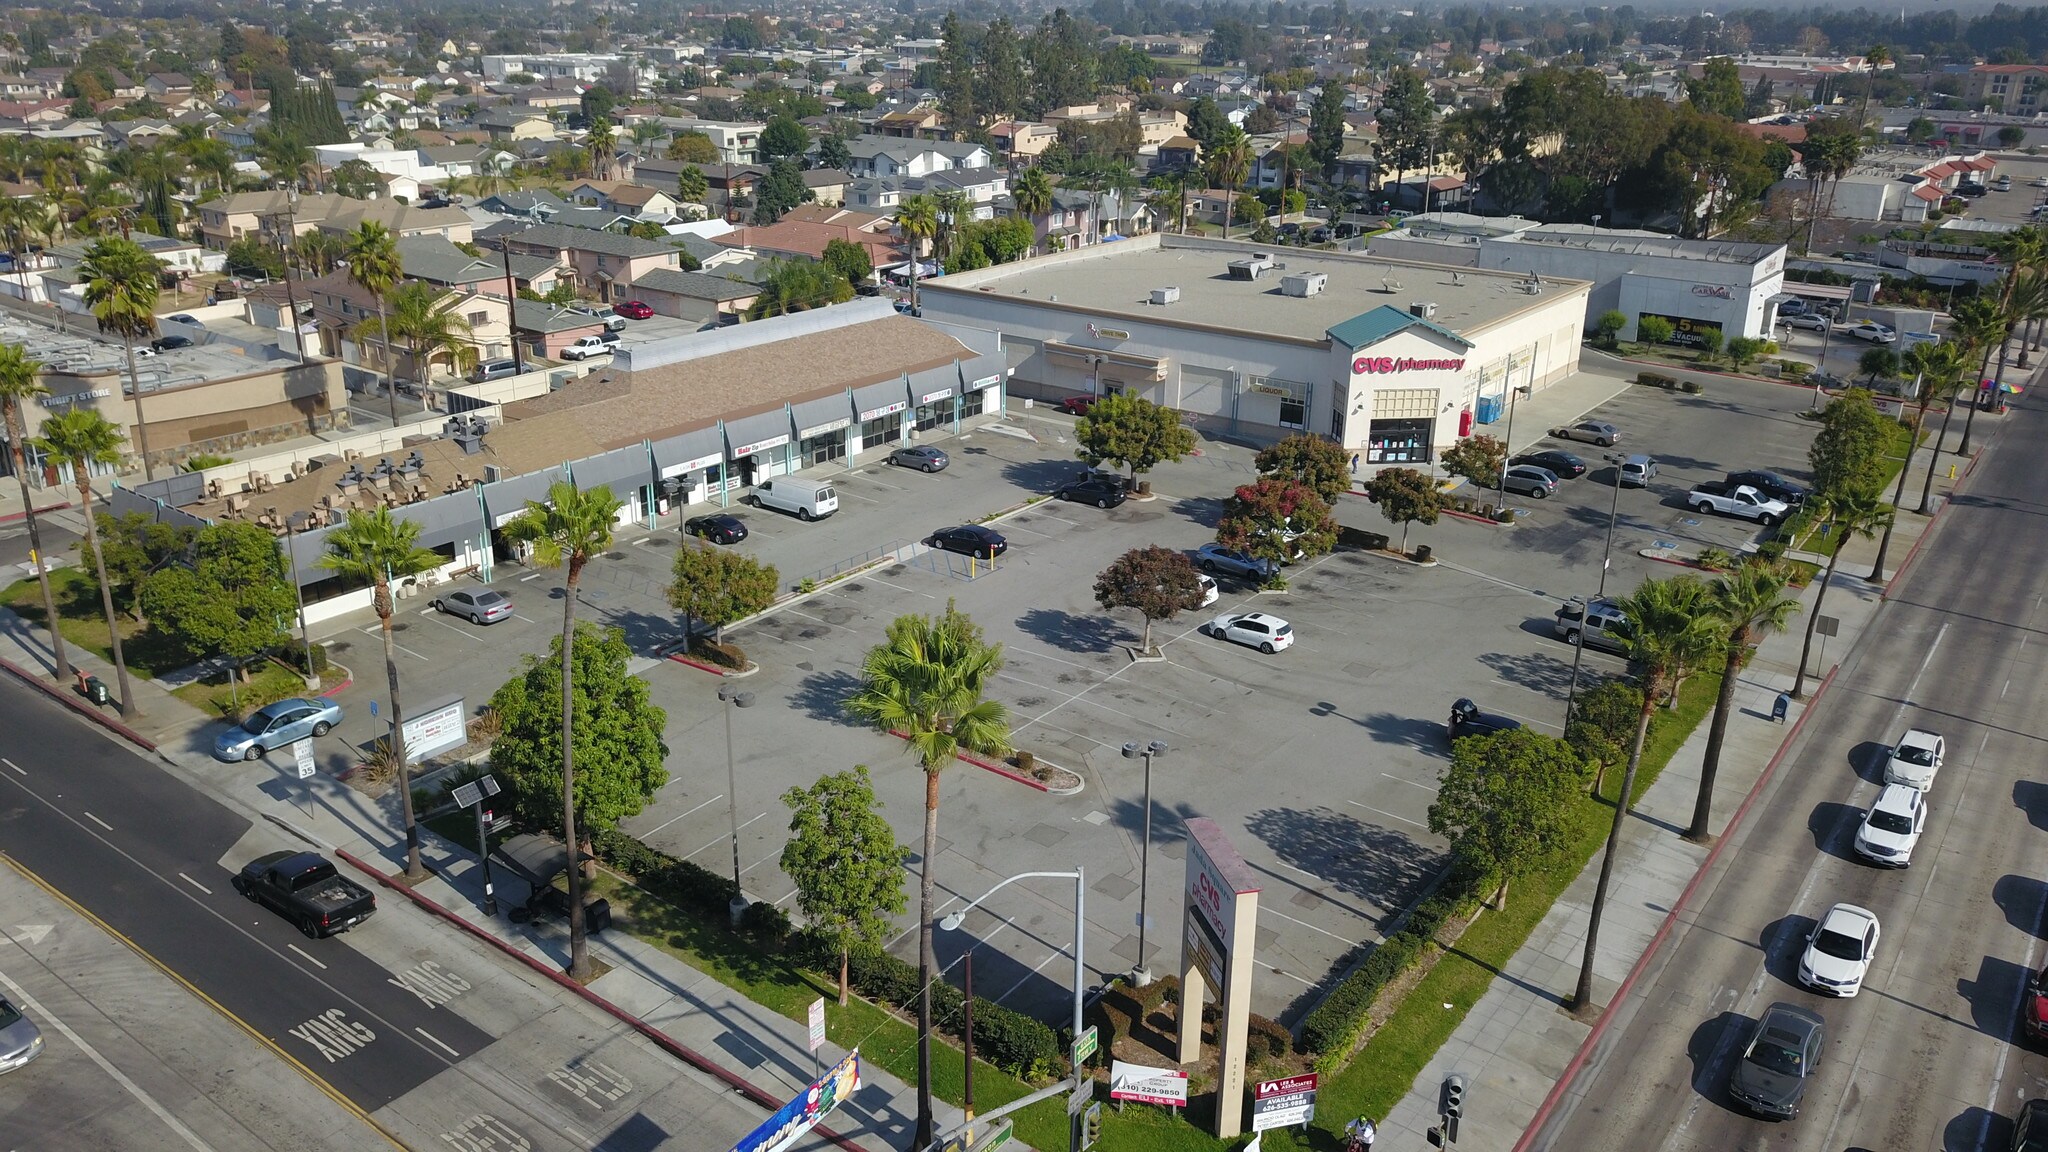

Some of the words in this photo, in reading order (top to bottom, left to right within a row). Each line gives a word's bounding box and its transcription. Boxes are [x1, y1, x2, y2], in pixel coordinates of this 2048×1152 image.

[1680, 319, 1691, 331] 5
[1354, 357, 1466, 374] CVS/pharmacy
[41, 394, 77, 407] THRIFT
[79, 388, 111, 400] STORE
[1260, 386, 1283, 396] LIQUOR
[737, 446, 751, 455] Hair
[301, 767, 313, 776] 35
[1200, 872, 1220, 911] CVS
[1192, 882, 1227, 940] pharmacy
[387, 960, 471, 1010] XING
[288, 1008, 376, 1063] XING
[1141, 1086, 1180, 1096] 229-9850
[1281, 1080, 1313, 1090] ASSOCIATES
[1267, 1093, 1304, 1106] AVAILABLE
